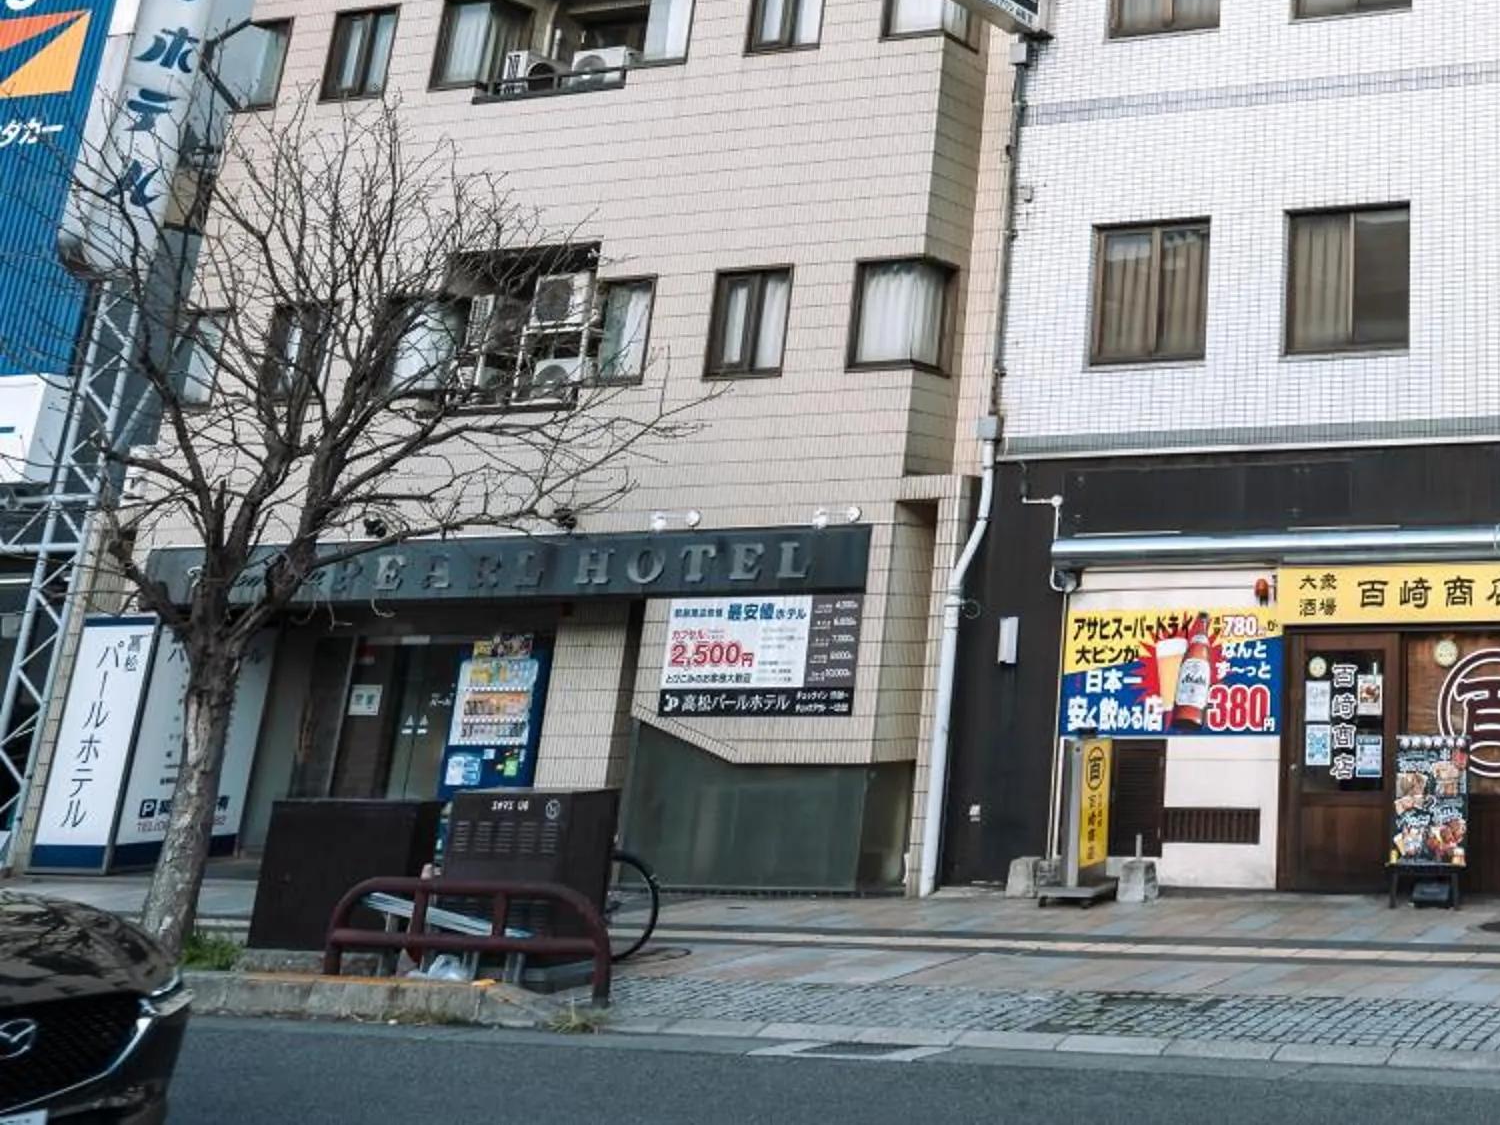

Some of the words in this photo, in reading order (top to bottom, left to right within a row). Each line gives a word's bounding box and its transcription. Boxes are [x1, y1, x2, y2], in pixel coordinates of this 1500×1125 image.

[574, 541, 812, 585] HOTEL
[1300, 574, 1337, 590] 大衆
[1300, 598, 1337, 617] 酒場
[1073, 616, 1193, 641] アサヒスーパードライ
[671, 642, 754, 667] 2,500円
[1075, 646, 1139, 664] 大ビンが
[1221, 641, 1267, 658] なんと
[1086, 669, 1142, 693] 日本一
[682, 693, 790, 712] 高松パールホテル
[1067, 696, 1163, 731] 安く飲める店
[61, 639, 124, 828] パールホテル
